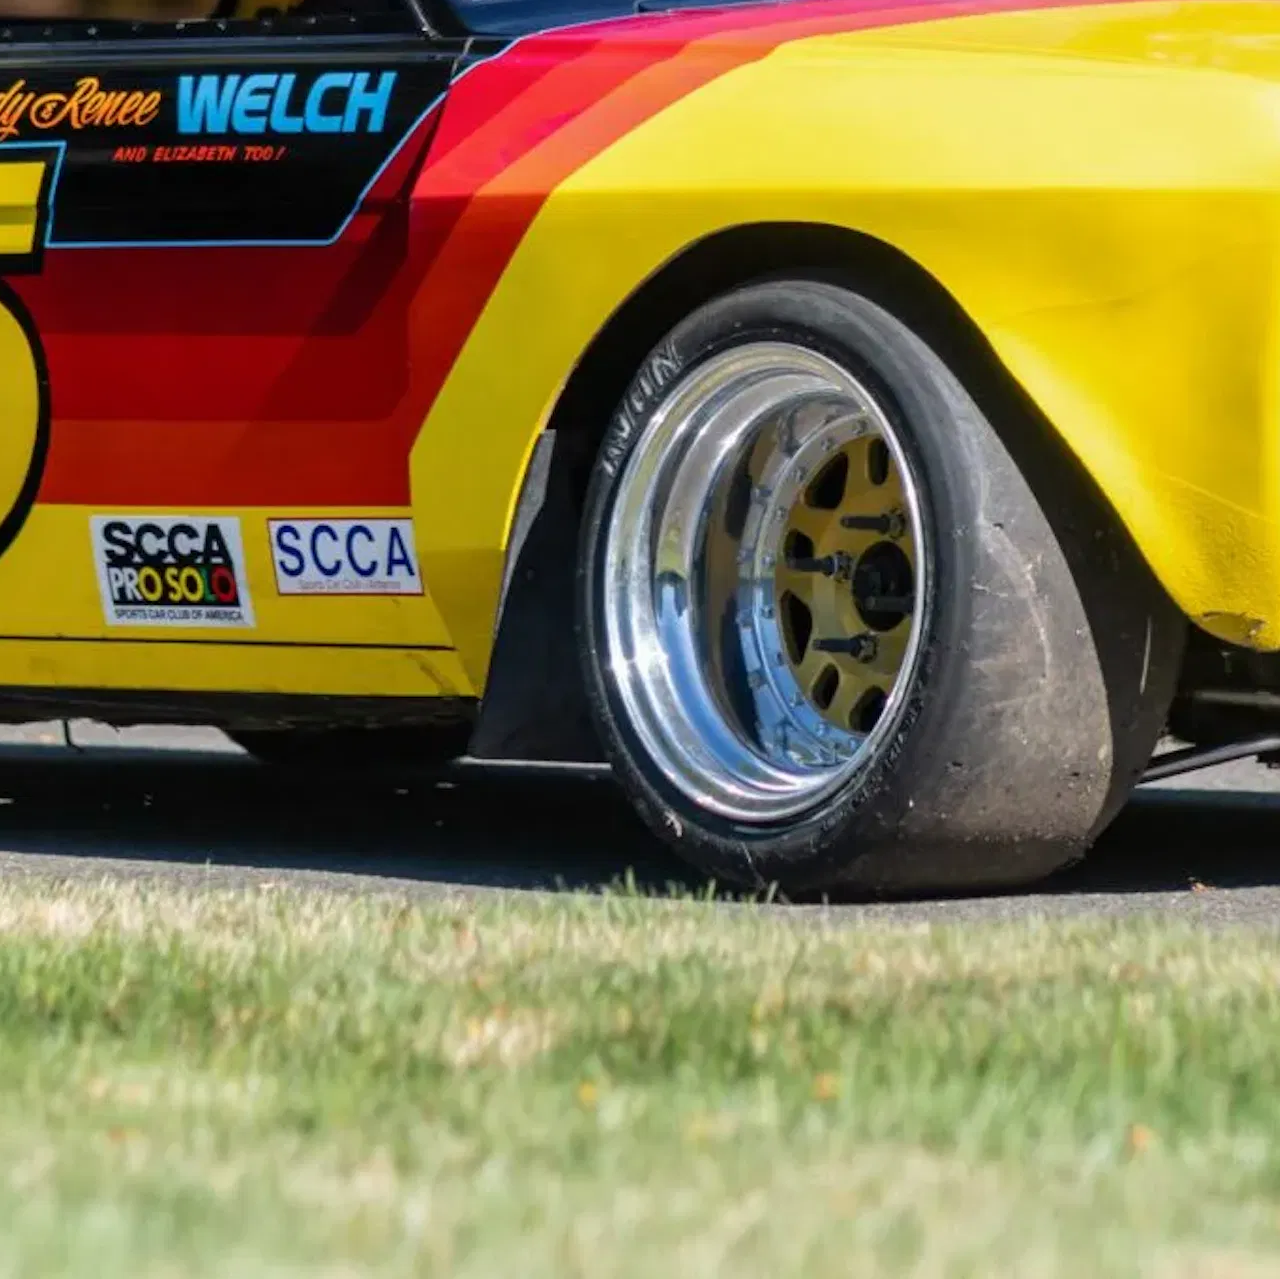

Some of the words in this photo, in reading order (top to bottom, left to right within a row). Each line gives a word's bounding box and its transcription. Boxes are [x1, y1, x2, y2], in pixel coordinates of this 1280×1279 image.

[31, 77, 162, 129] Renee
[176, 71, 398, 135] WELCH
[113, 146, 147, 162] AND
[153, 145, 236, 162] ELIZABETH
[102, 521, 235, 564] SCCA
[275, 524, 416, 577] SCCA
[109, 566, 163, 602] PRO
[166, 566, 237, 603] SOLO
